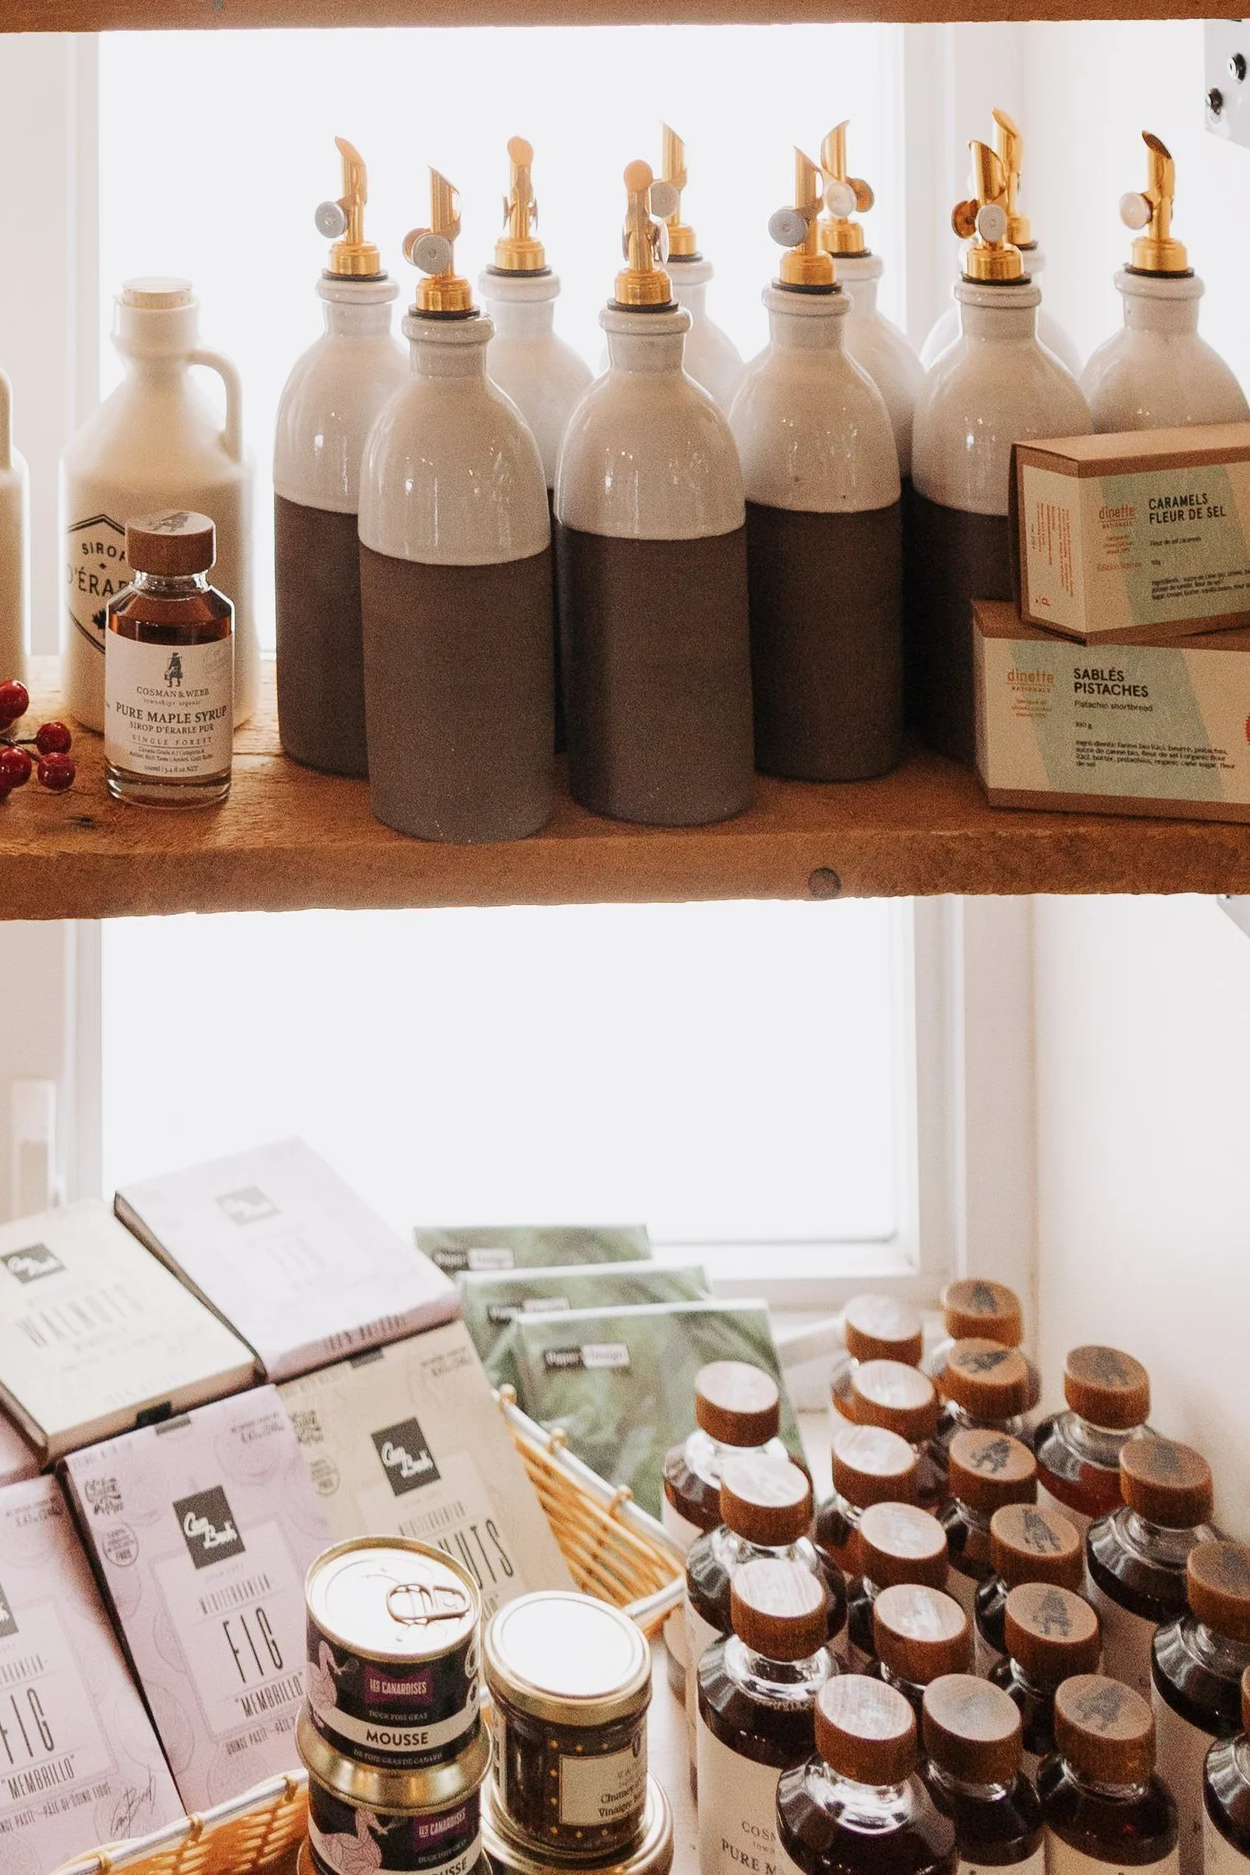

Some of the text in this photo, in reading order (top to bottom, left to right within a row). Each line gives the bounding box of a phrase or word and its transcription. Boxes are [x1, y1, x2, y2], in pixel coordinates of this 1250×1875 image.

[1149, 493, 1209, 510] CARAMELS
[1099, 504, 1136, 520] dinette
[1149, 506, 1227, 525] FLEUR DE SEL
[1074, 667, 1125, 682] SABLÉS
[136, 686, 177, 698] COSMAN
[1074, 682, 1149, 697] PISTACHES
[116, 701, 227, 724] PURE MAPLE SYRUP
[1111, 701, 1153, 712] shortbread
[130, 722, 197, 734] SIROP D'ÉRABLE
[222, 1606, 283, 1684] FIG
[369, 1679, 381, 1692] LES
[369, 1711, 389, 1721] DUCK
[366, 1729, 429, 1747] MOUSSE
[721, 1837, 760, 1872] PURE
